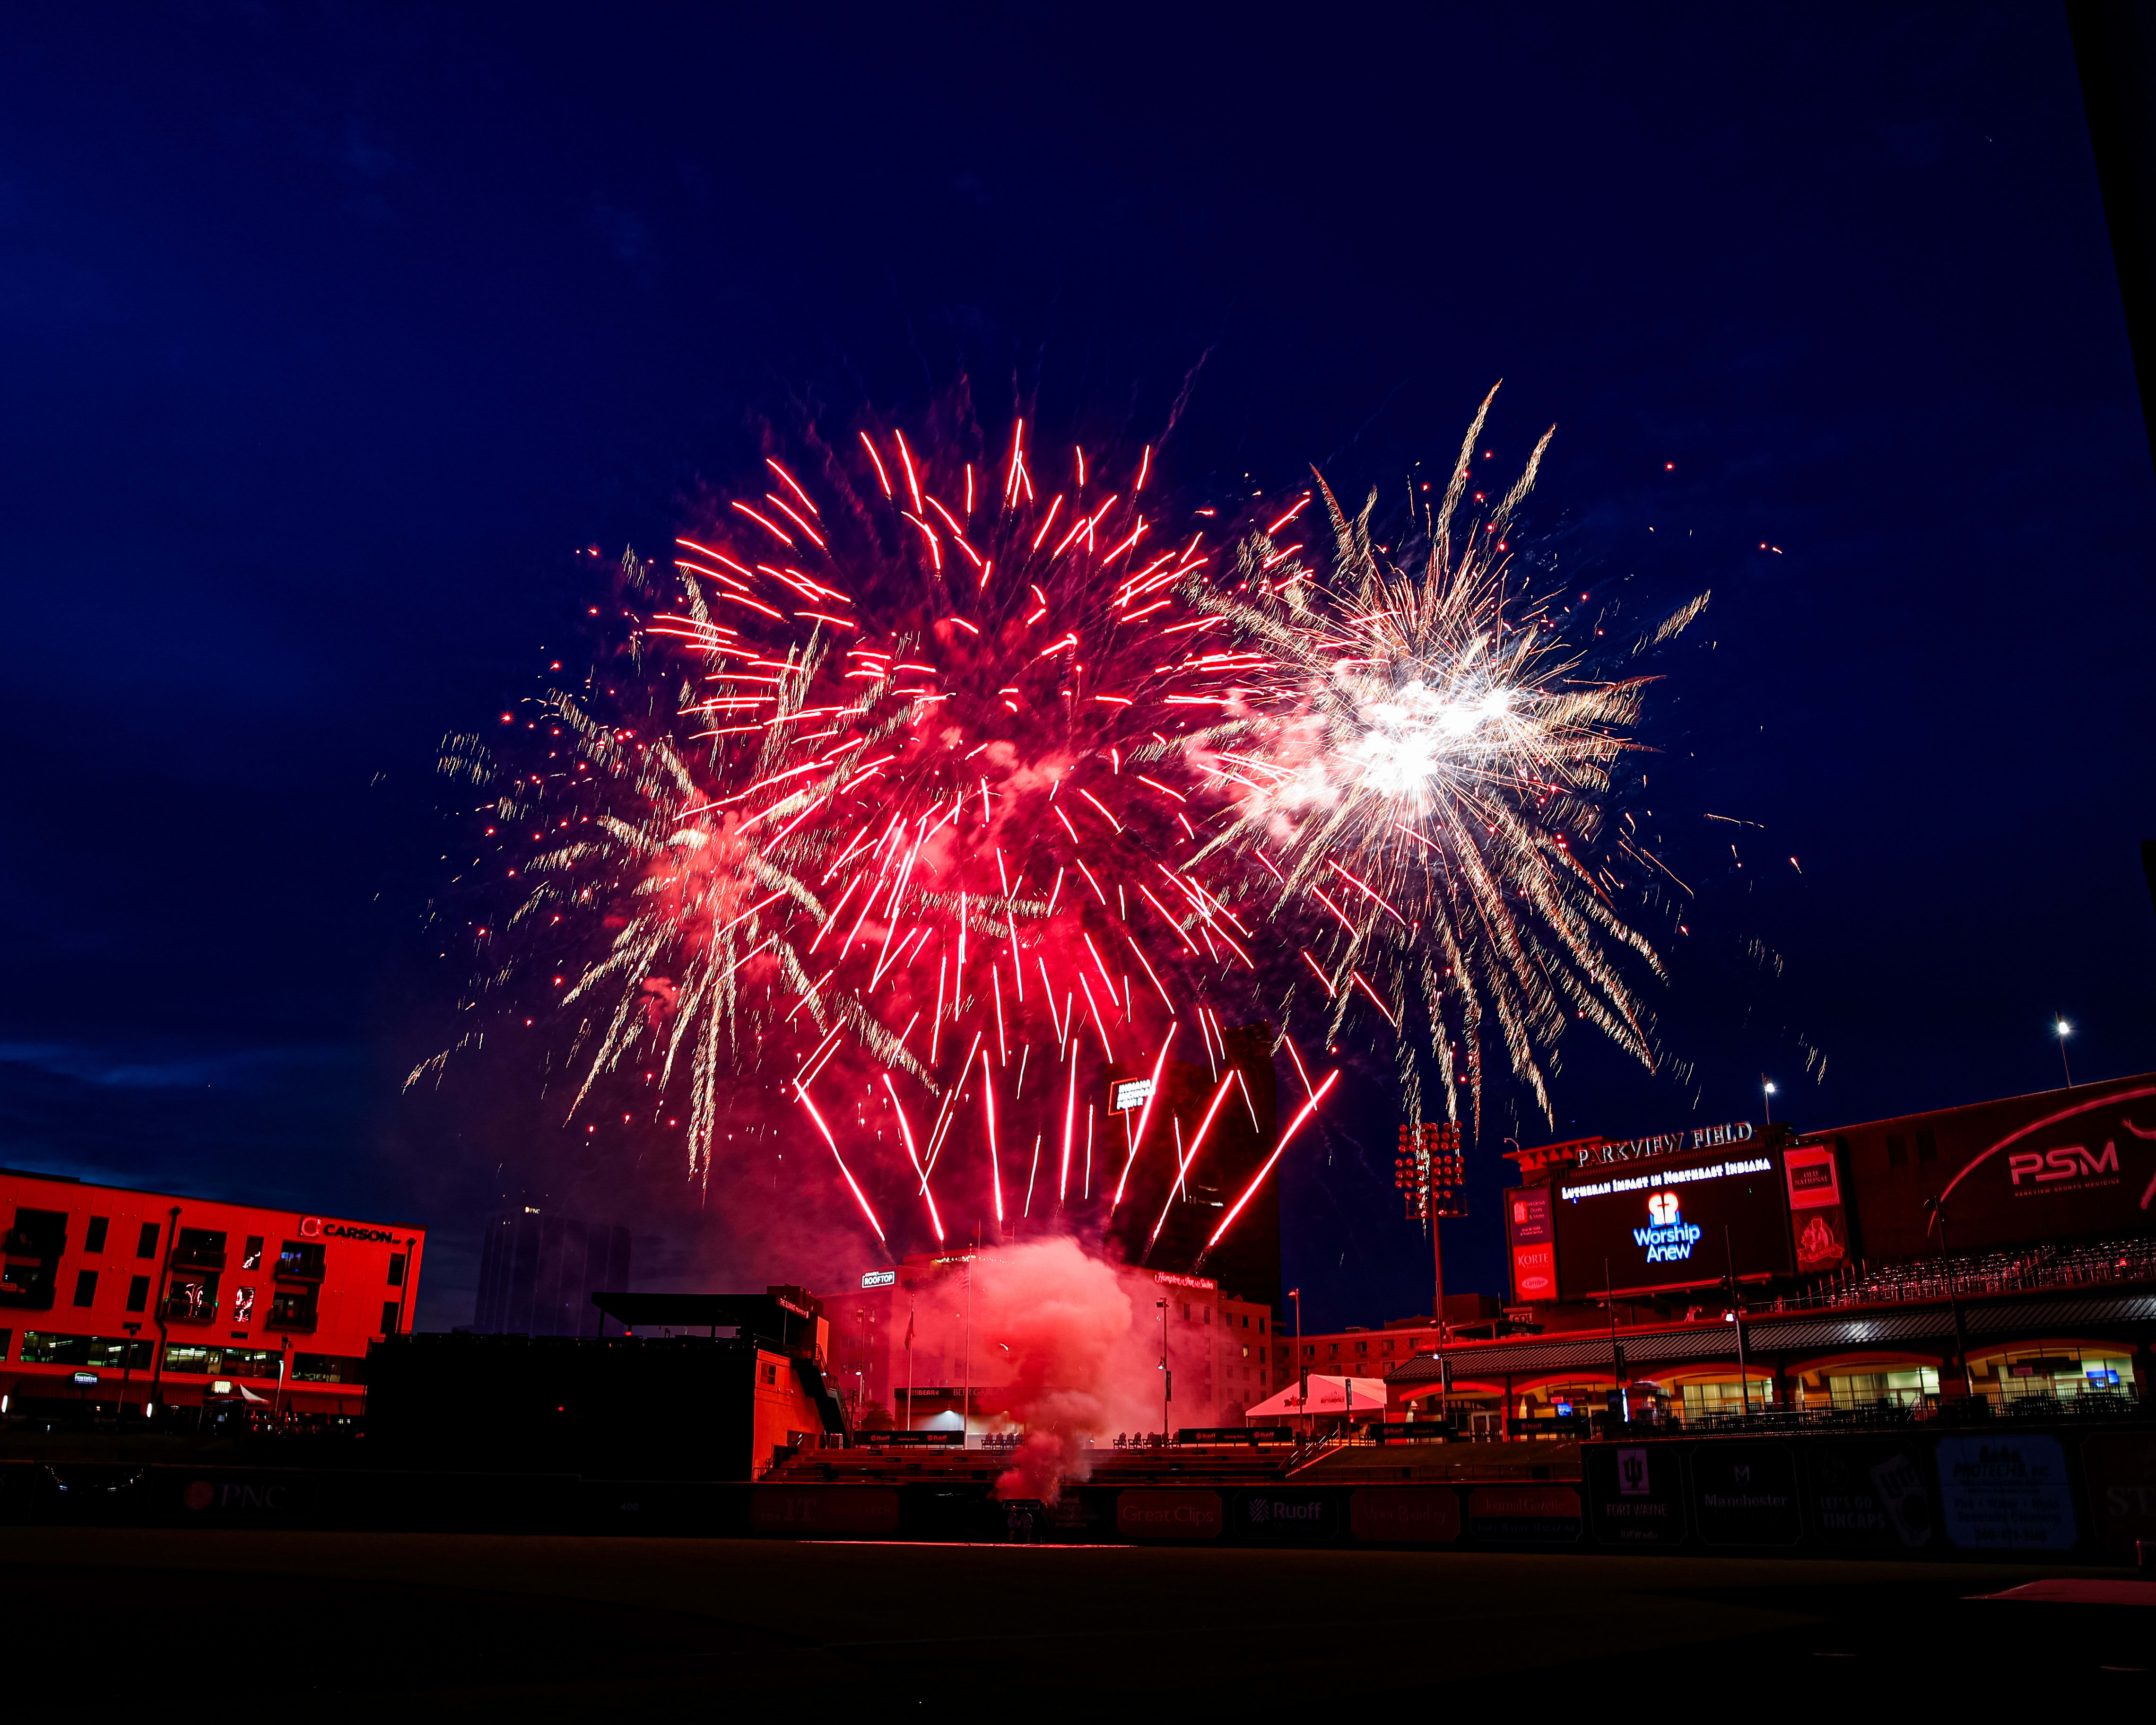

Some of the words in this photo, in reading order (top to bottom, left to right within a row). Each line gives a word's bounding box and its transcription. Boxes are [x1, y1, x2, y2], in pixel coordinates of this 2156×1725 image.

[1578, 1133, 1684, 1167] PARKVIEW
[1690, 1122, 1752, 1150] FIELD
[2009, 1139, 2119, 1185] PSM
[323, 1224, 392, 1243] CARSON
[1633, 1221, 1702, 1247] Worship
[1518, 1253, 1548, 1269] KORTE
[1647, 1242, 1692, 1263] Anew
[865, 1274, 893, 1285] ROOFTOP
[1155, 1272, 1182, 1286] Hampton
[221, 1484, 287, 1509] PNC
[1705, 1494, 1788, 1507] Manchester
[620, 1502, 639, 1512] 400
[1274, 1501, 1321, 1519] Ruoff
[1606, 1503, 1630, 1517] FORT
[1634, 1502, 1668, 1517] WAYNE
[761, 1513, 780, 1521] FOR
[1123, 1505, 1171, 1522] Great
[1174, 1505, 1214, 1527] Clips
[1822, 1513, 1885, 1529] TINCAPS
